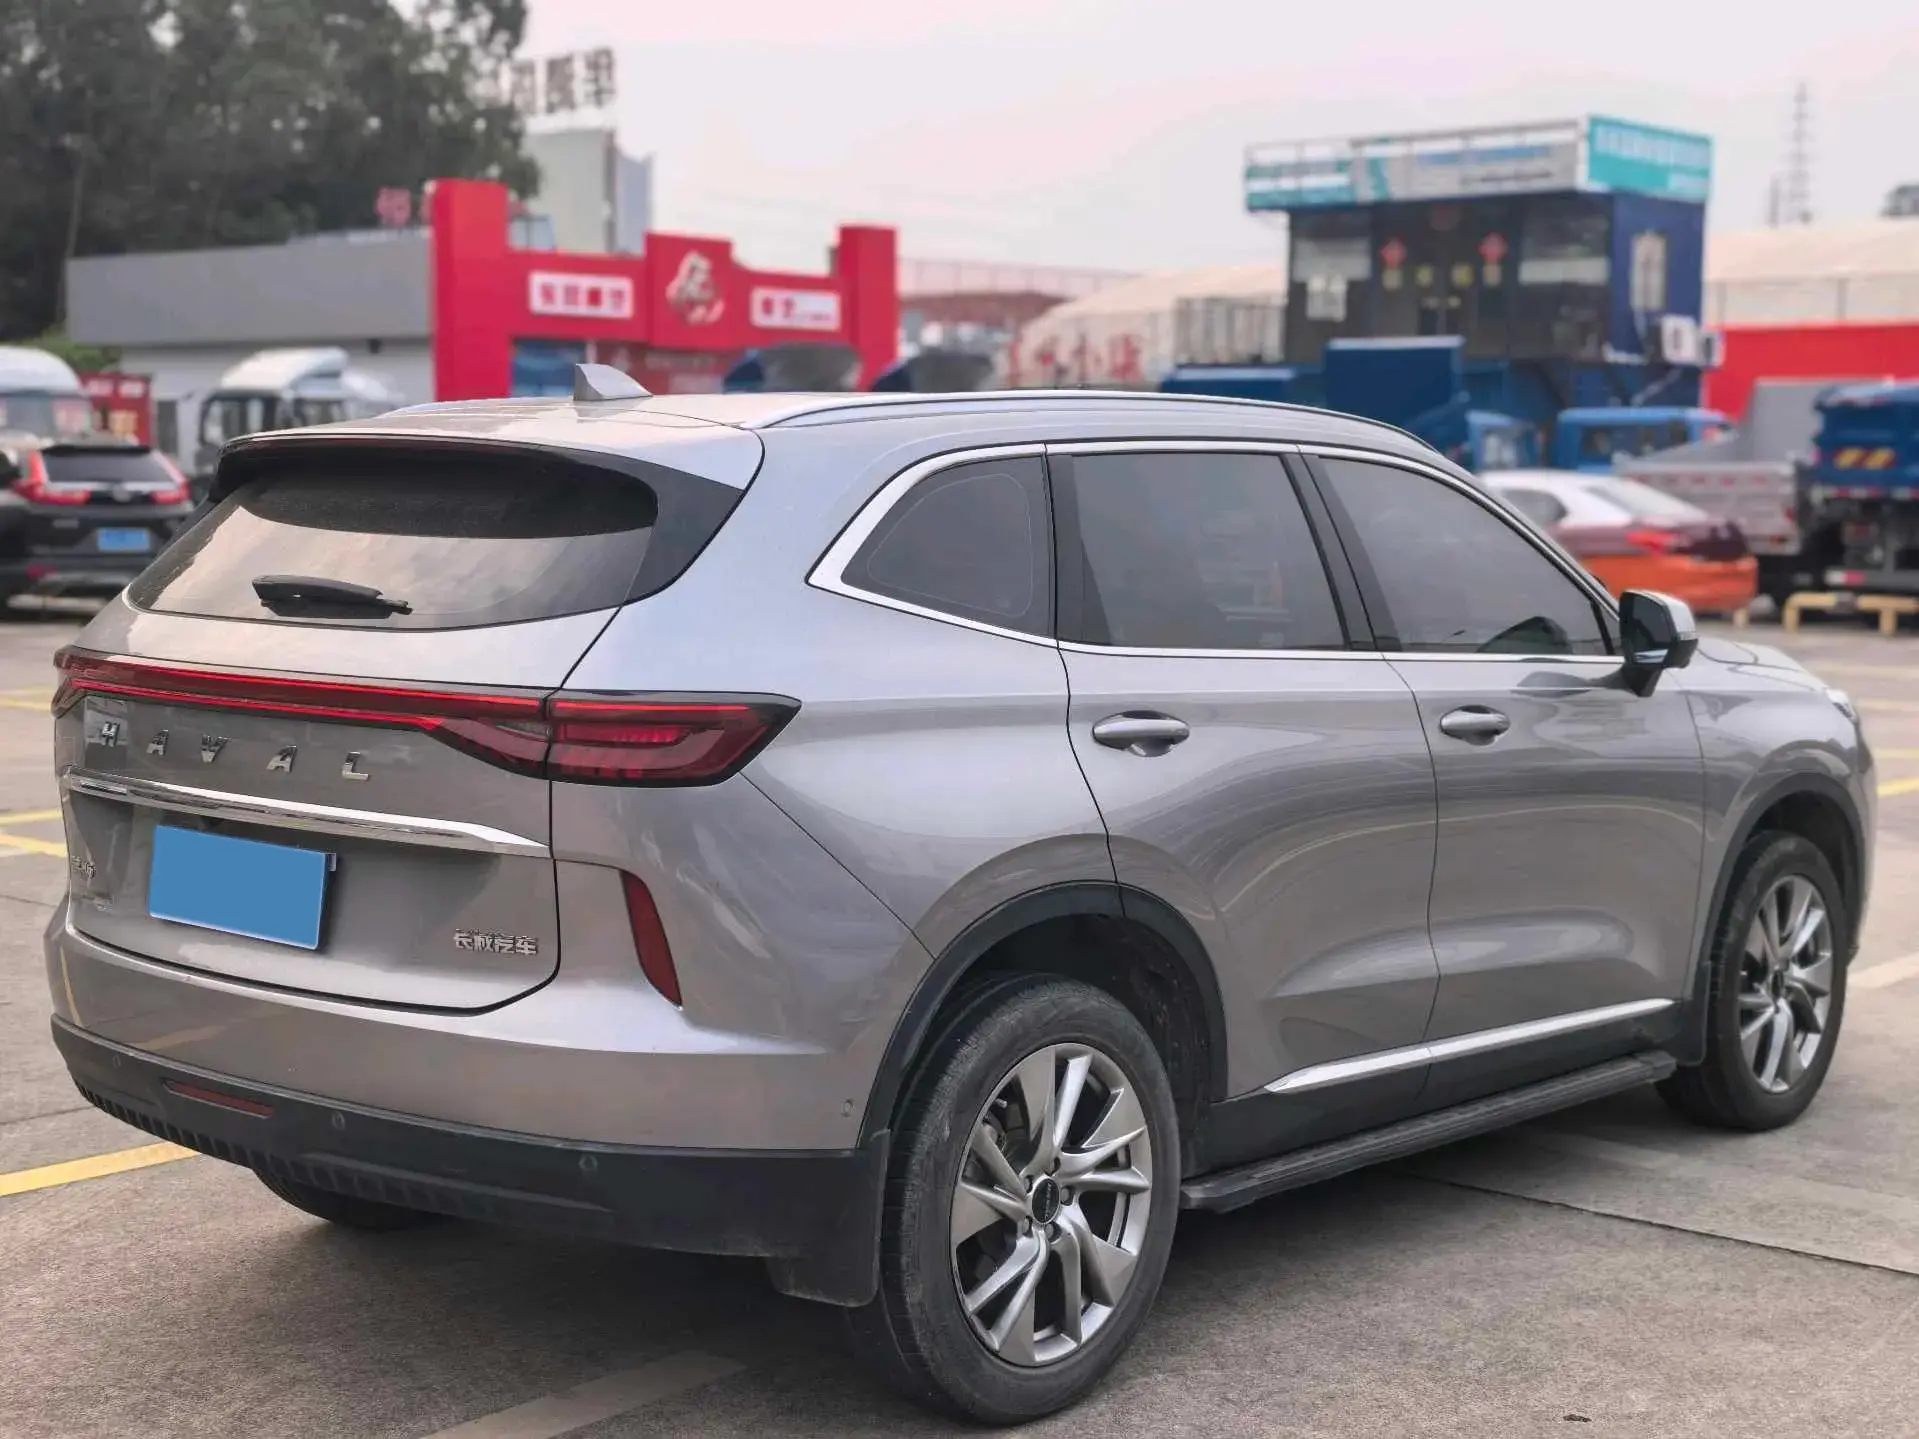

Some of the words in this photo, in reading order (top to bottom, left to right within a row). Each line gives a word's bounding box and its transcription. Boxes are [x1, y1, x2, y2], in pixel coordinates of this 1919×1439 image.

[101, 721, 369, 780] HAVAL
[453, 929, 538, 956] 长城汽车
